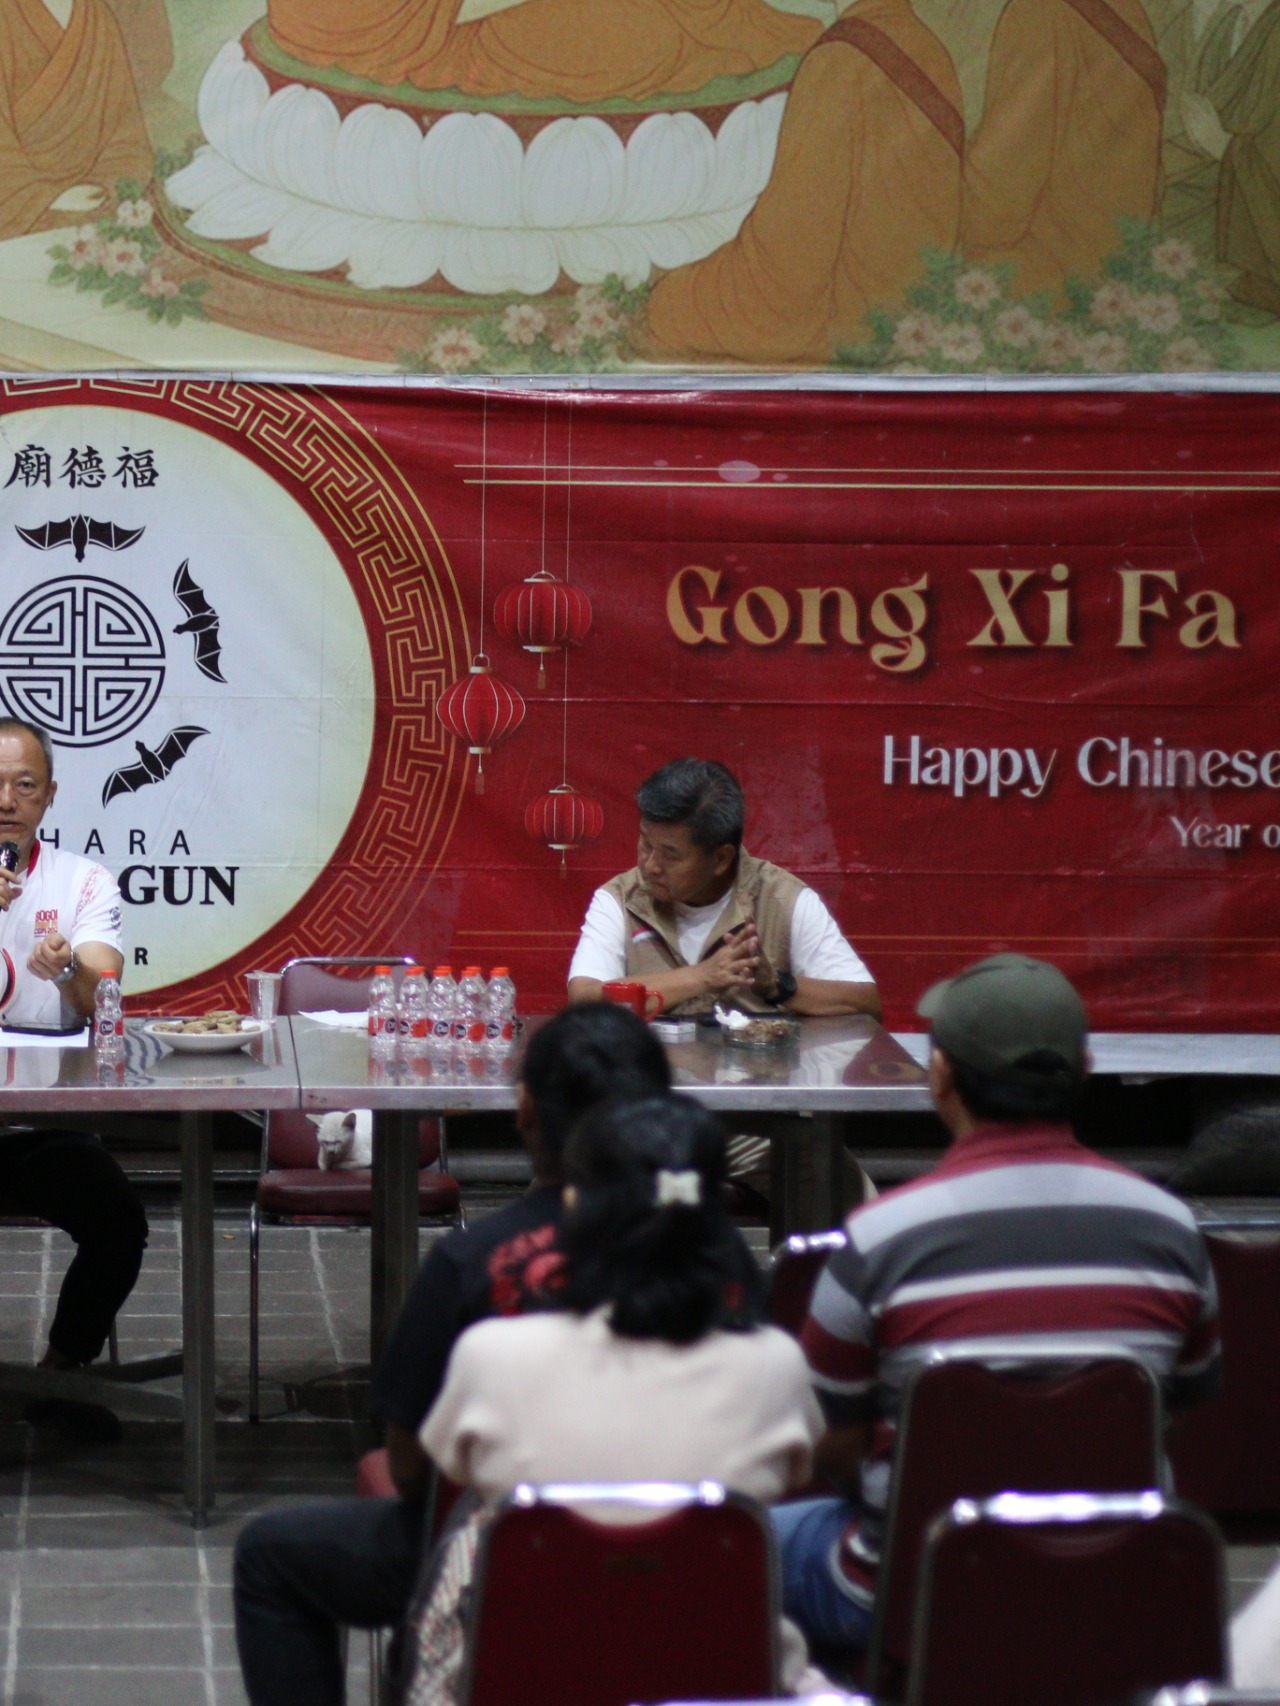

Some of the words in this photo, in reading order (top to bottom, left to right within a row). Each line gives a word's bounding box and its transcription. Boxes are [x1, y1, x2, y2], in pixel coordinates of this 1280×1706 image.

[667, 566, 928, 673] Gong
[968, 563, 1073, 647] Xi
[1116, 570, 1240, 648] Fa
[884, 734, 1057, 798] Happy
[1077, 736, 1280, 788] Chinese
[1170, 816, 1251, 848] Year
